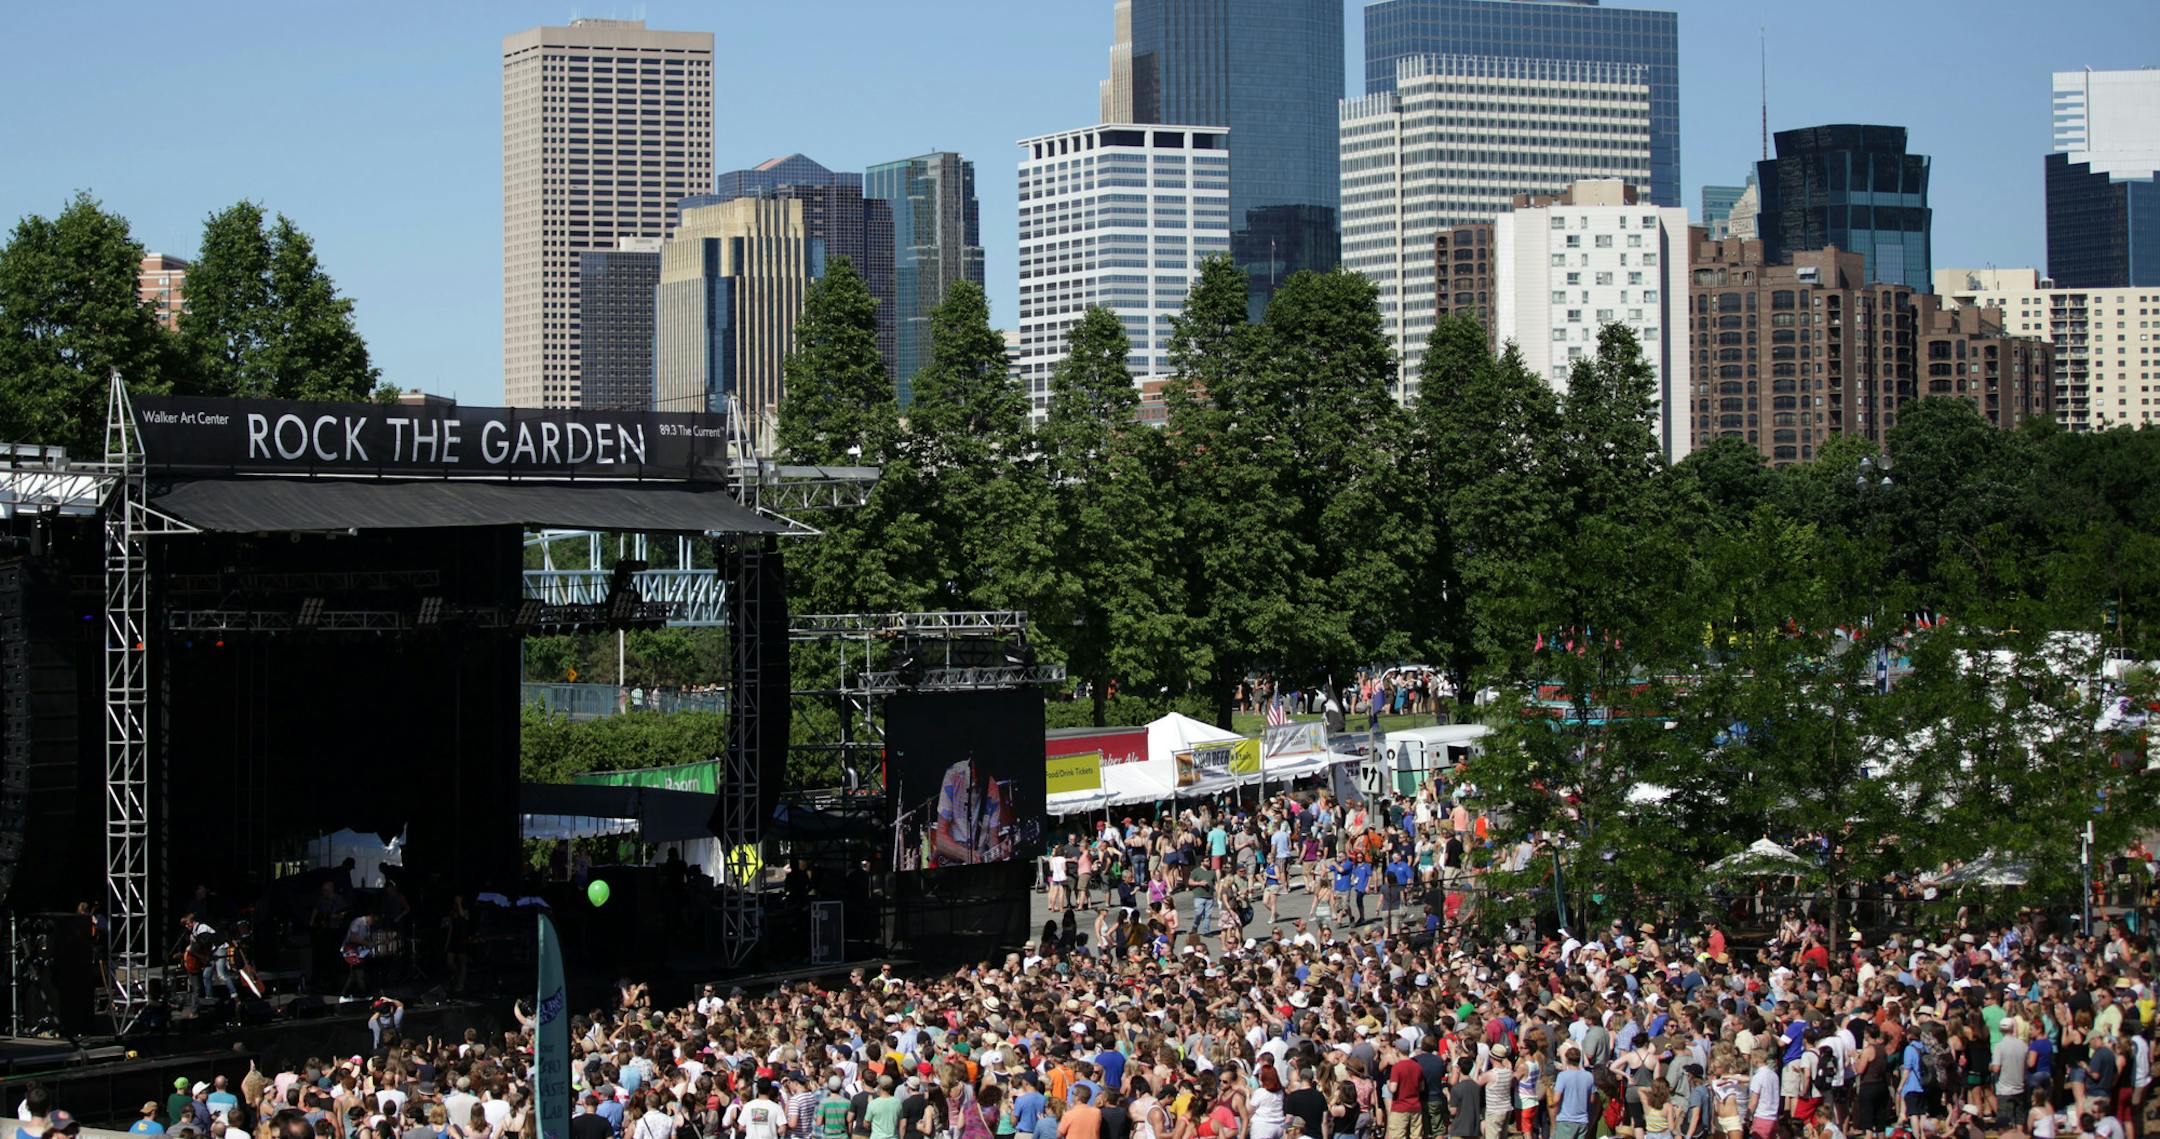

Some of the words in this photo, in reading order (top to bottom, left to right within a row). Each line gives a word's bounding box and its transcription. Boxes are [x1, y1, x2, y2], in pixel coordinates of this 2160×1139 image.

[142, 410, 178, 424] Walker
[180, 411, 196, 424] Art
[198, 412, 229, 425] Center
[659, 424, 677, 436] 89.3
[679, 425, 692, 437] The
[247, 412, 370, 462] ROCK
[386, 417, 461, 463] THE
[481, 419, 646, 465] GARDEN
[1212, 750, 1230, 765] BEER
[1076, 767, 1093, 776] Tickets
[665, 777, 699, 793] Room
